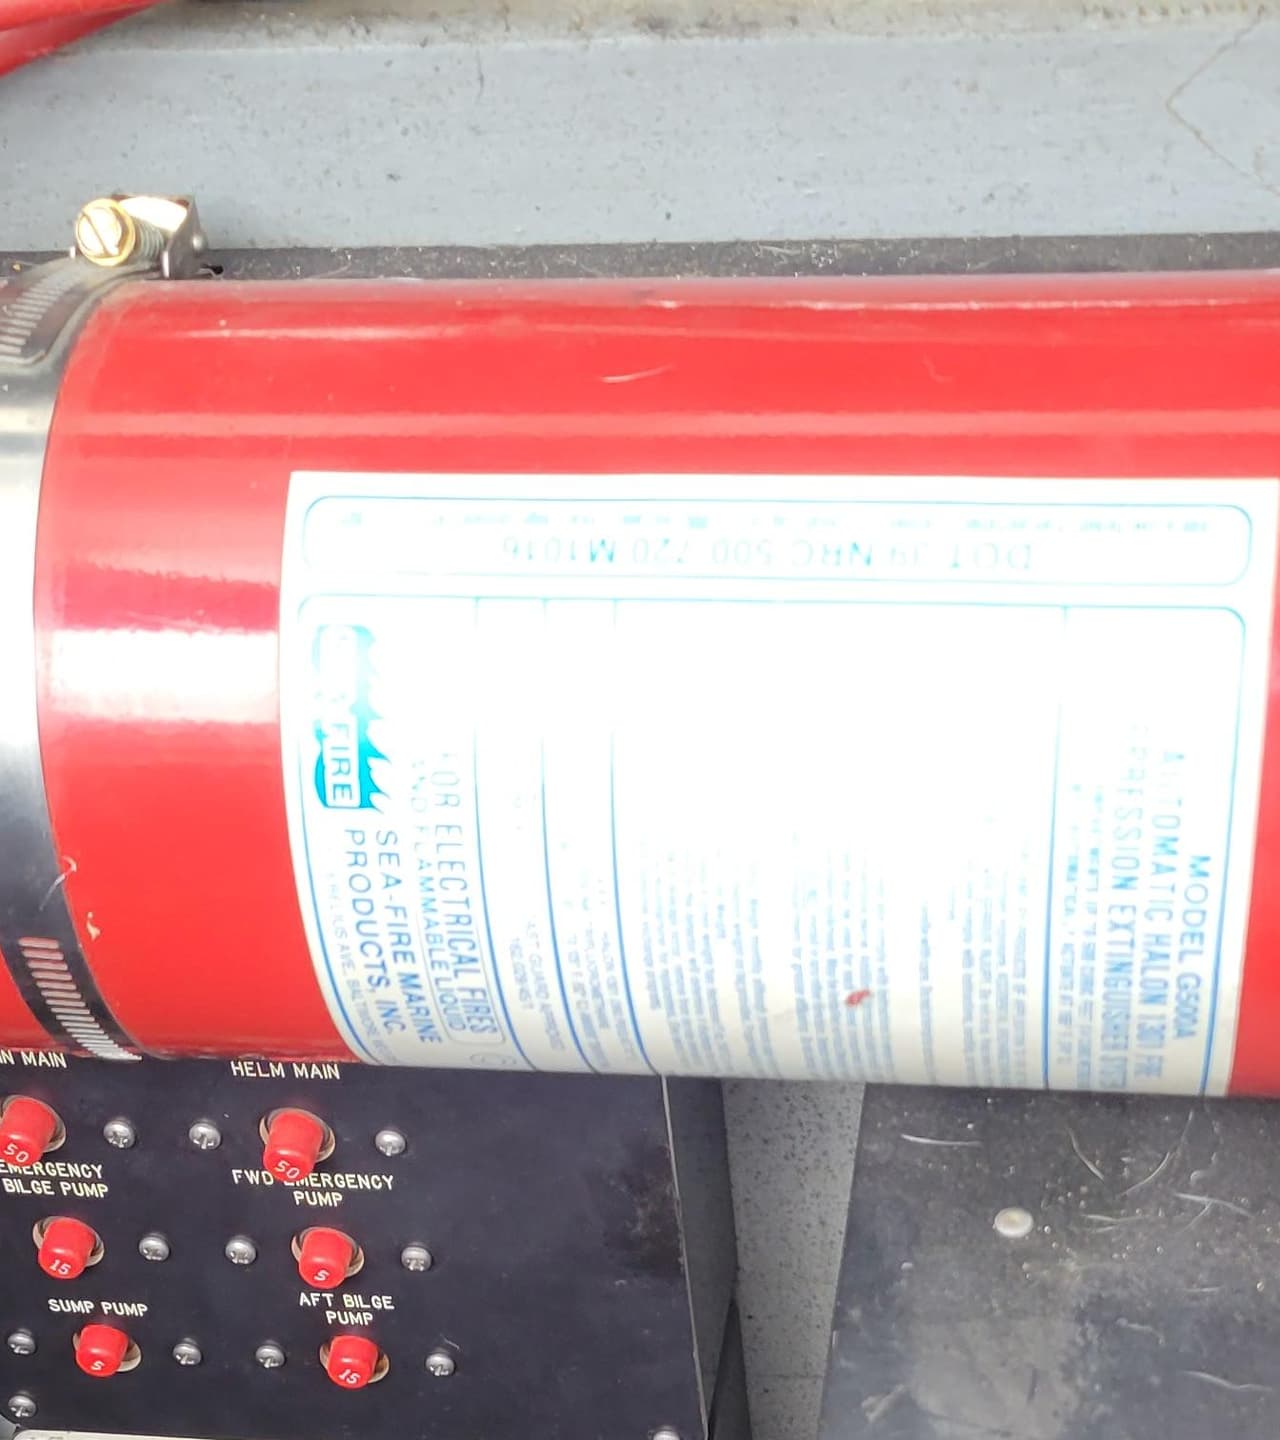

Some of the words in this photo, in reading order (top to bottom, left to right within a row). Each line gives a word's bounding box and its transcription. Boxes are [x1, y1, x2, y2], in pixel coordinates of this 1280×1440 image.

[328, 721, 355, 804] FIRE
[1144, 748, 1186, 923] ATOMATIC
[414, 824, 449, 974] FLAMMABLE
[1178, 854, 1212, 965] MODEL
[377, 829, 417, 965] SEA-FIRE
[398, 971, 444, 1045] MARINE
[435, 823, 483, 979] ELECTRICAL
[466, 985, 499, 1036] FIRES
[1138, 932, 1173, 1006] HALON
[22, 1050, 67, 1068] MAIN
[231, 1061, 286, 1078] HELM
[293, 1062, 341, 1080] MAIN
[3, 1143, 31, 1164] 50
[231, 1169, 276, 1185] FWD
[274, 1159, 300, 1179] 50
[1, 1178, 55, 1196] BILGE
[60, 1180, 109, 1199] PUMP
[293, 1190, 343, 1208] PUMP
[49, 1258, 72, 1275] 15
[47, 1298, 95, 1315] SUMP
[101, 1300, 148, 1318] PUMP
[299, 1292, 334, 1308] AFT
[342, 1292, 395, 1310] BILGE
[325, 1310, 373, 1326] PUMP
[337, 1367, 362, 1386] 15
